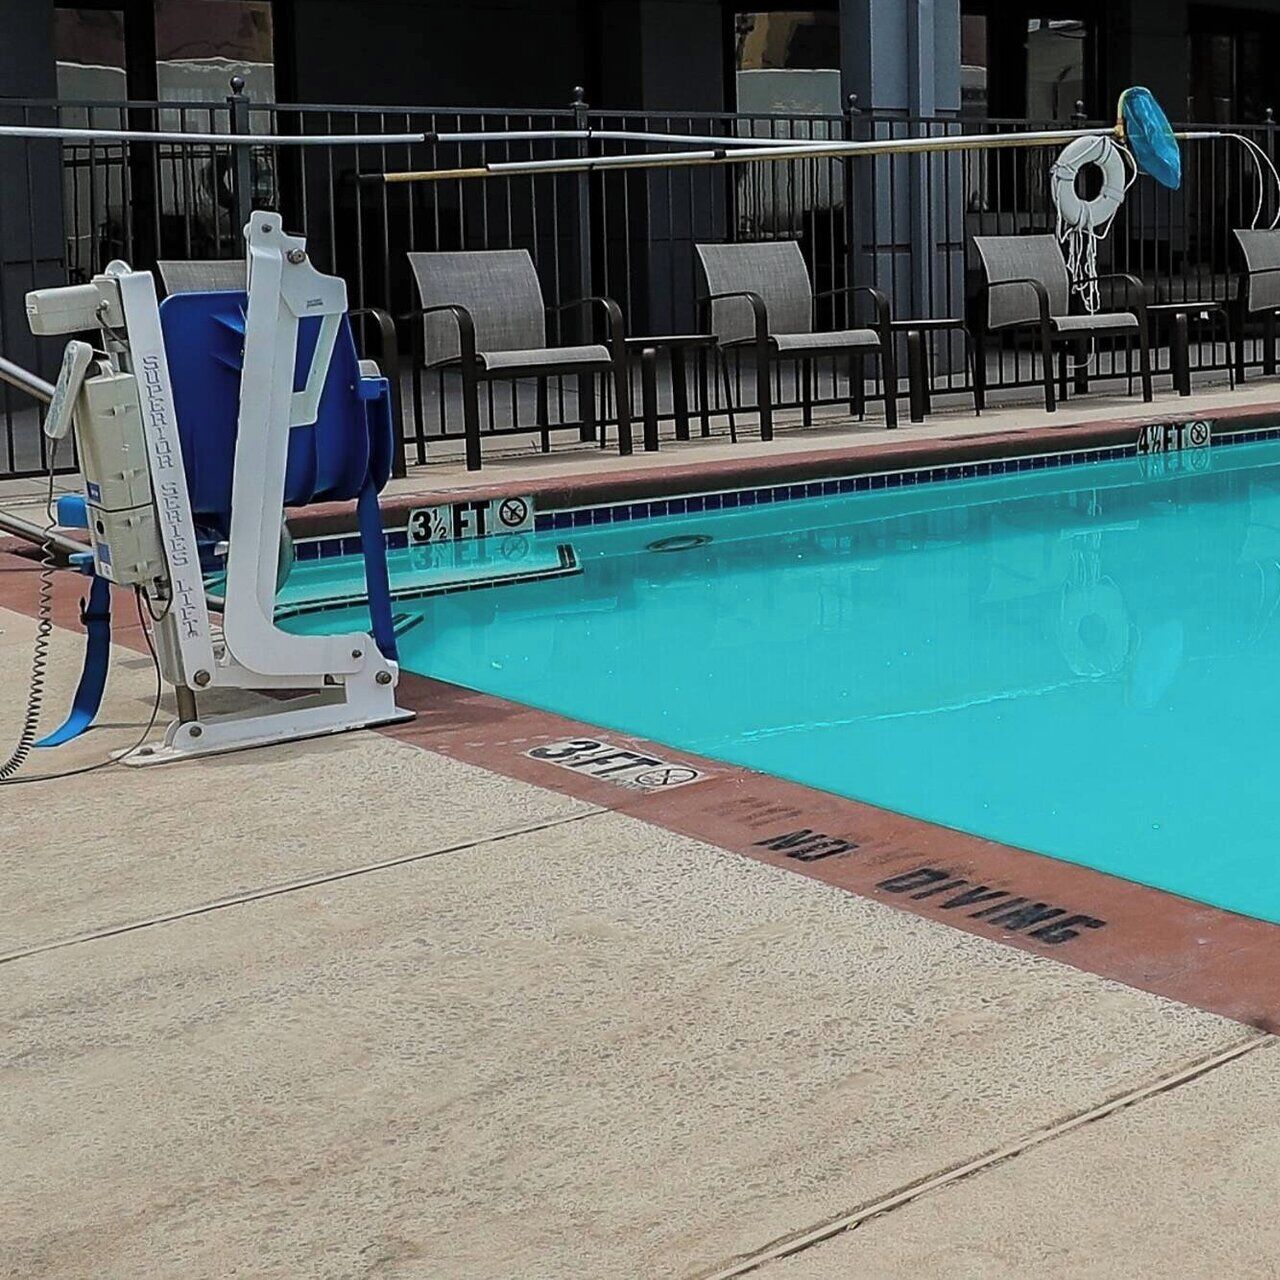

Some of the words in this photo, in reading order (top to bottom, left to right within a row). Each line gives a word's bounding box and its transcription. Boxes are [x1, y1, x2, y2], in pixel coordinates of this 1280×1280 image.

[143, 355, 174, 469] SUPERIOR
[161, 482, 189, 566] SERIES
[176, 580, 199, 636] LIFT
[752, 829, 860, 862] NO
[875, 868, 1107, 945] DIVING
